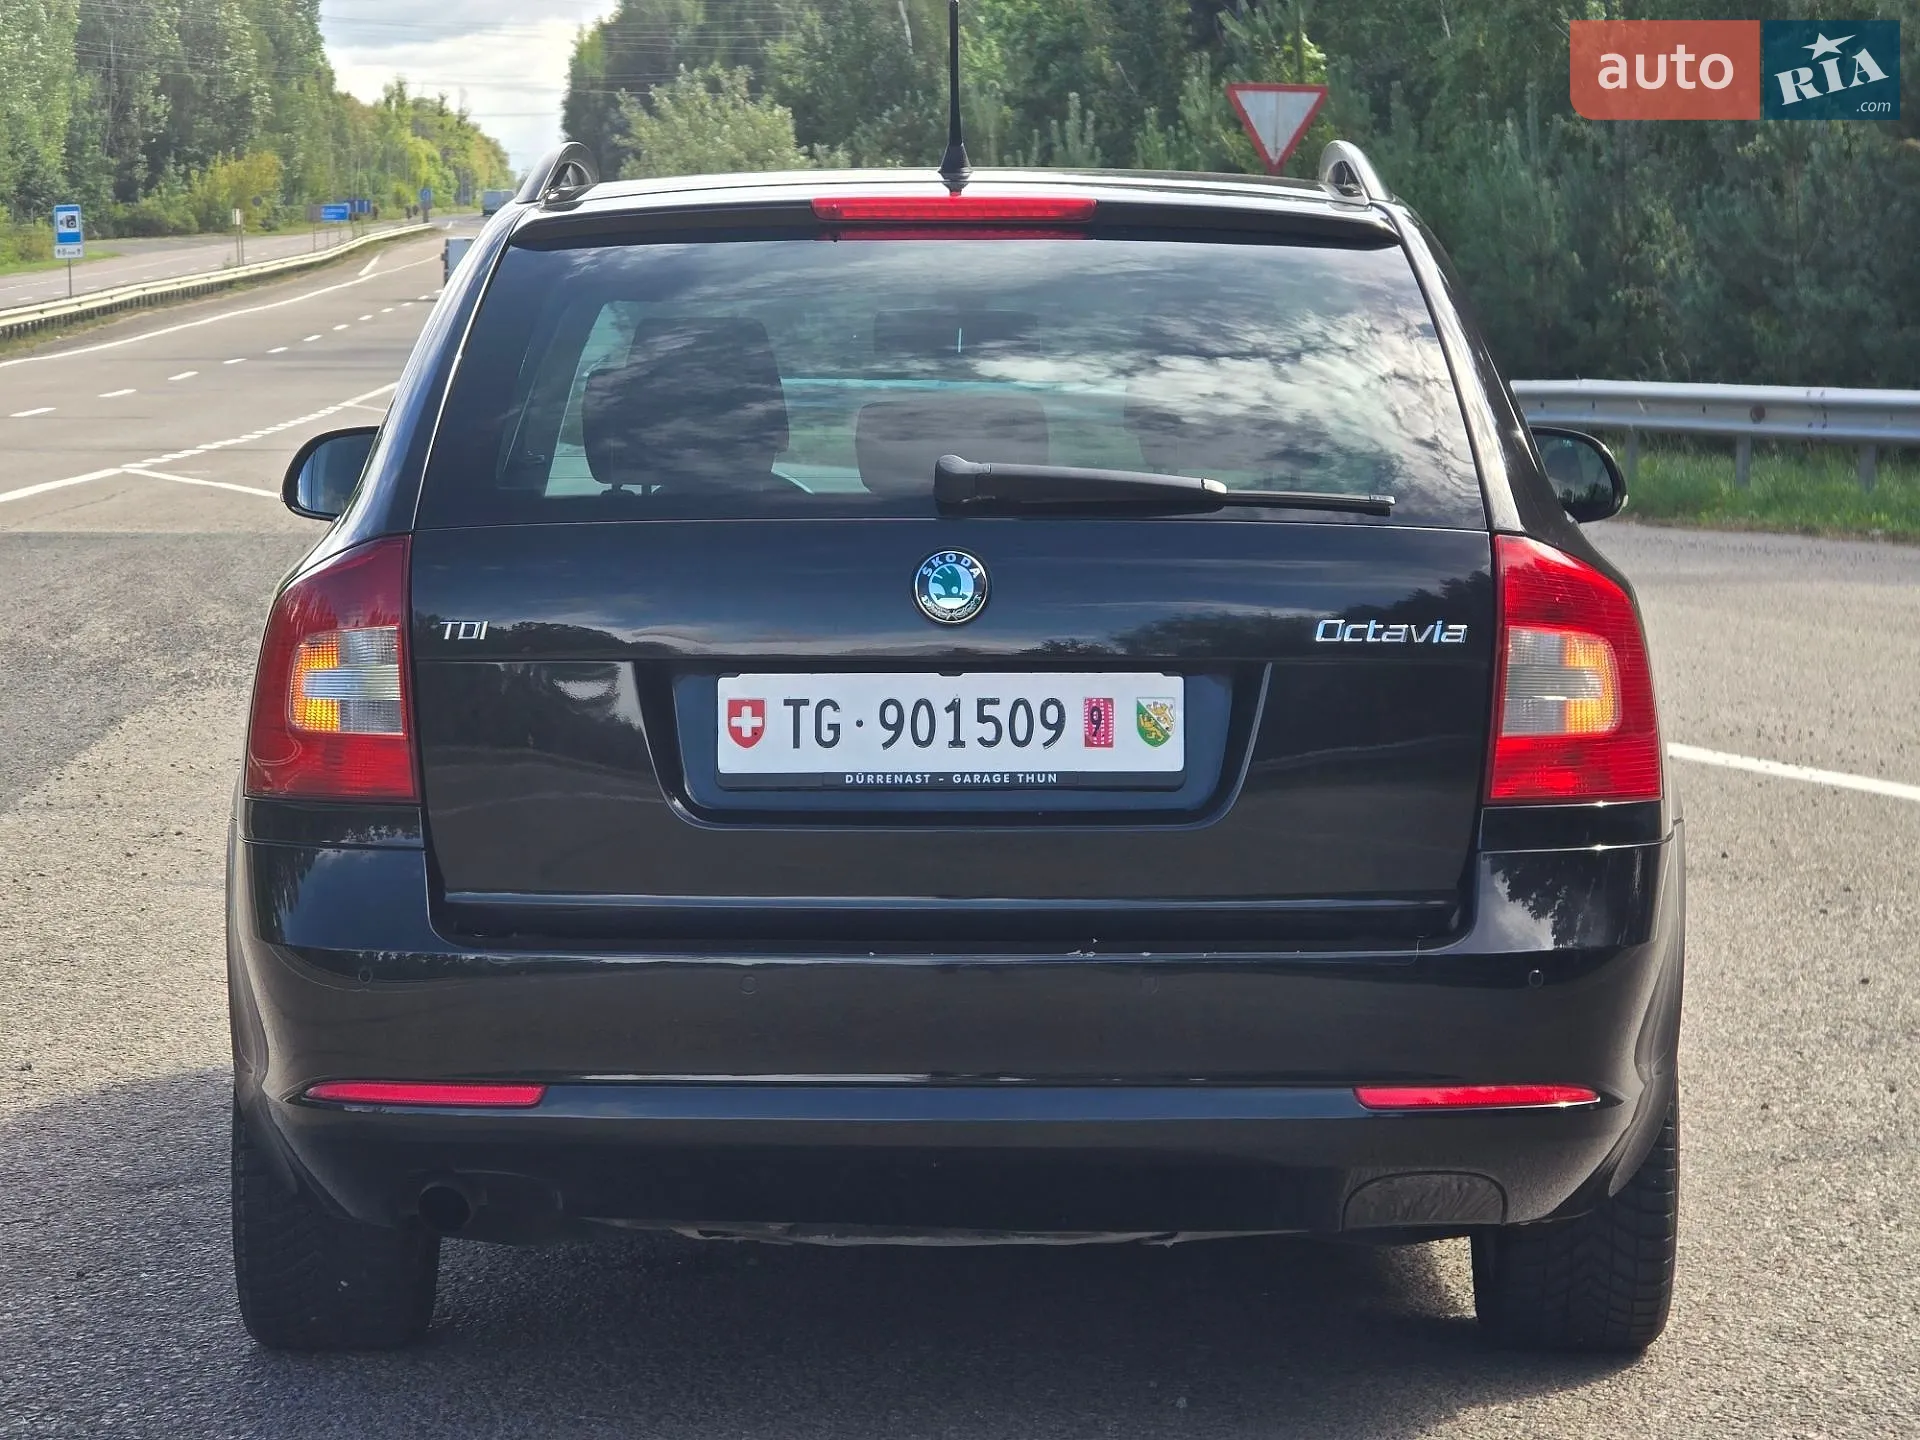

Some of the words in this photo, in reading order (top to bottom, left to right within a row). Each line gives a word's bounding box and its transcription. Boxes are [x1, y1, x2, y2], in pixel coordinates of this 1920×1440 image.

[440, 620, 489, 640] TDI
[1315, 619, 1468, 643] Octavia
[845, 772, 931, 784] DÜRRENAST
[952, 773, 1010, 784] GARAGE
[1017, 773, 1058, 783] THUN
